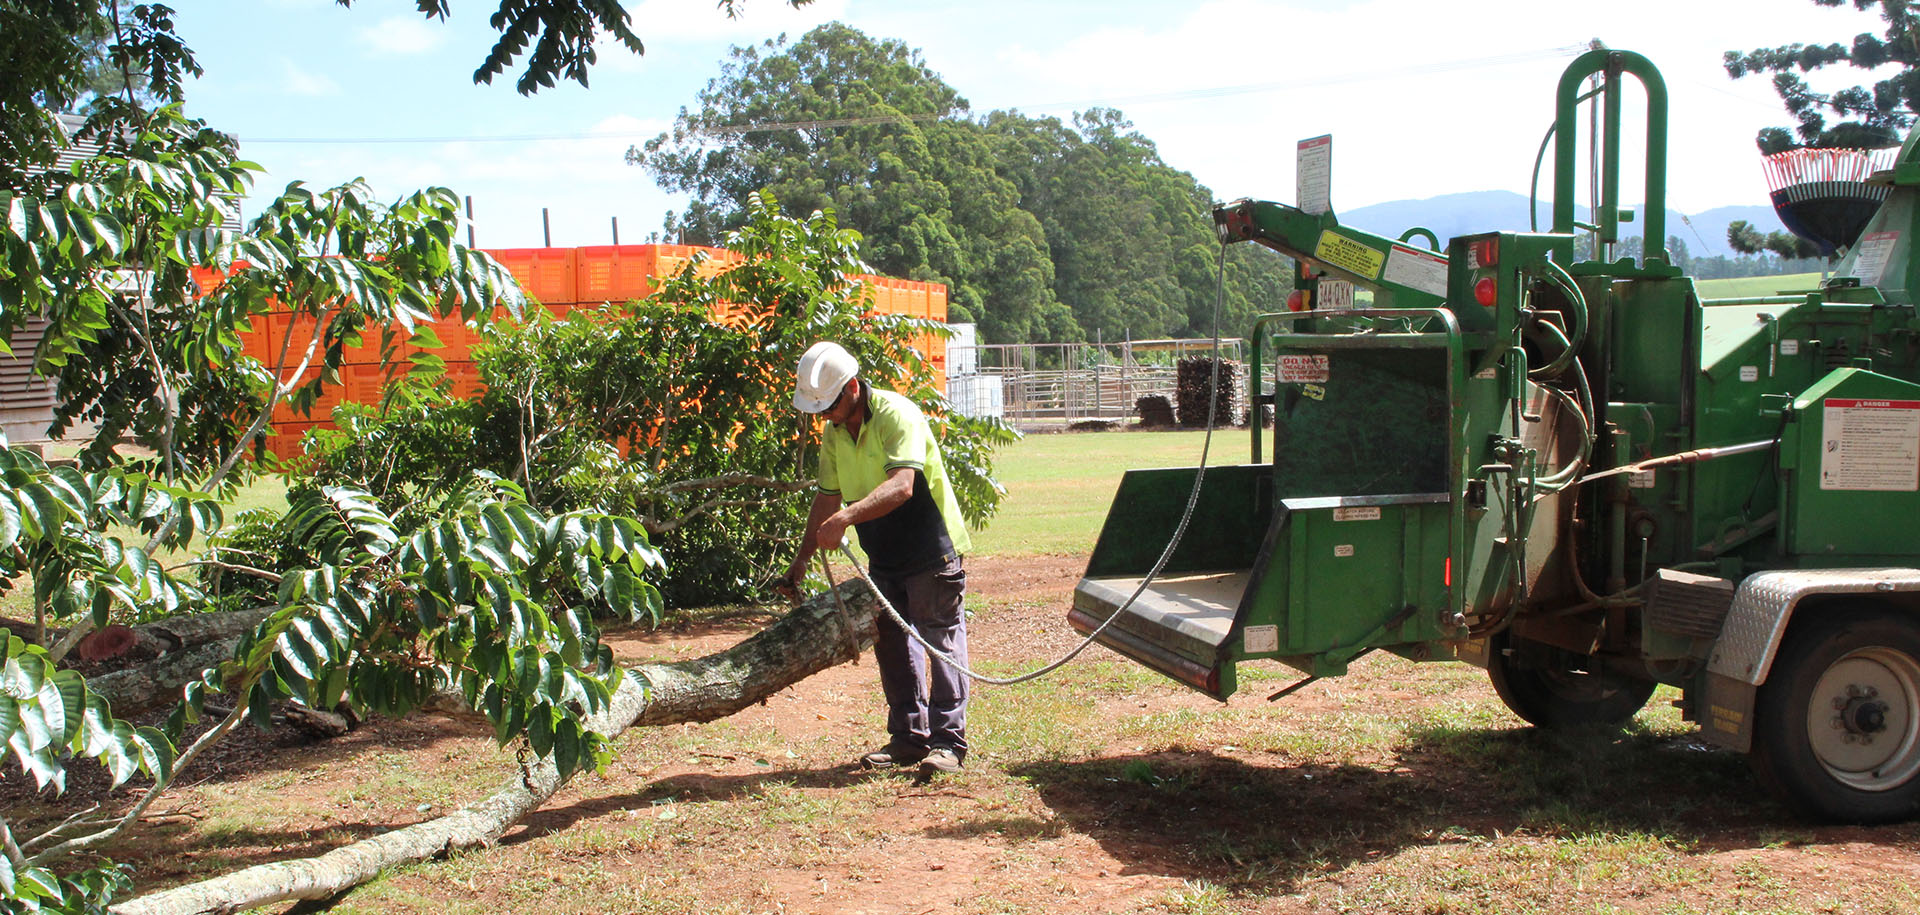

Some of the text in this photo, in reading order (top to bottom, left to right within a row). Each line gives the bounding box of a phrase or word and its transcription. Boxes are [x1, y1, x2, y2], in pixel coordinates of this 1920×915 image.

[1321, 241, 1333, 249] MUST
[1339, 239, 1367, 253] WARNING
[1319, 283, 1332, 306] 344
